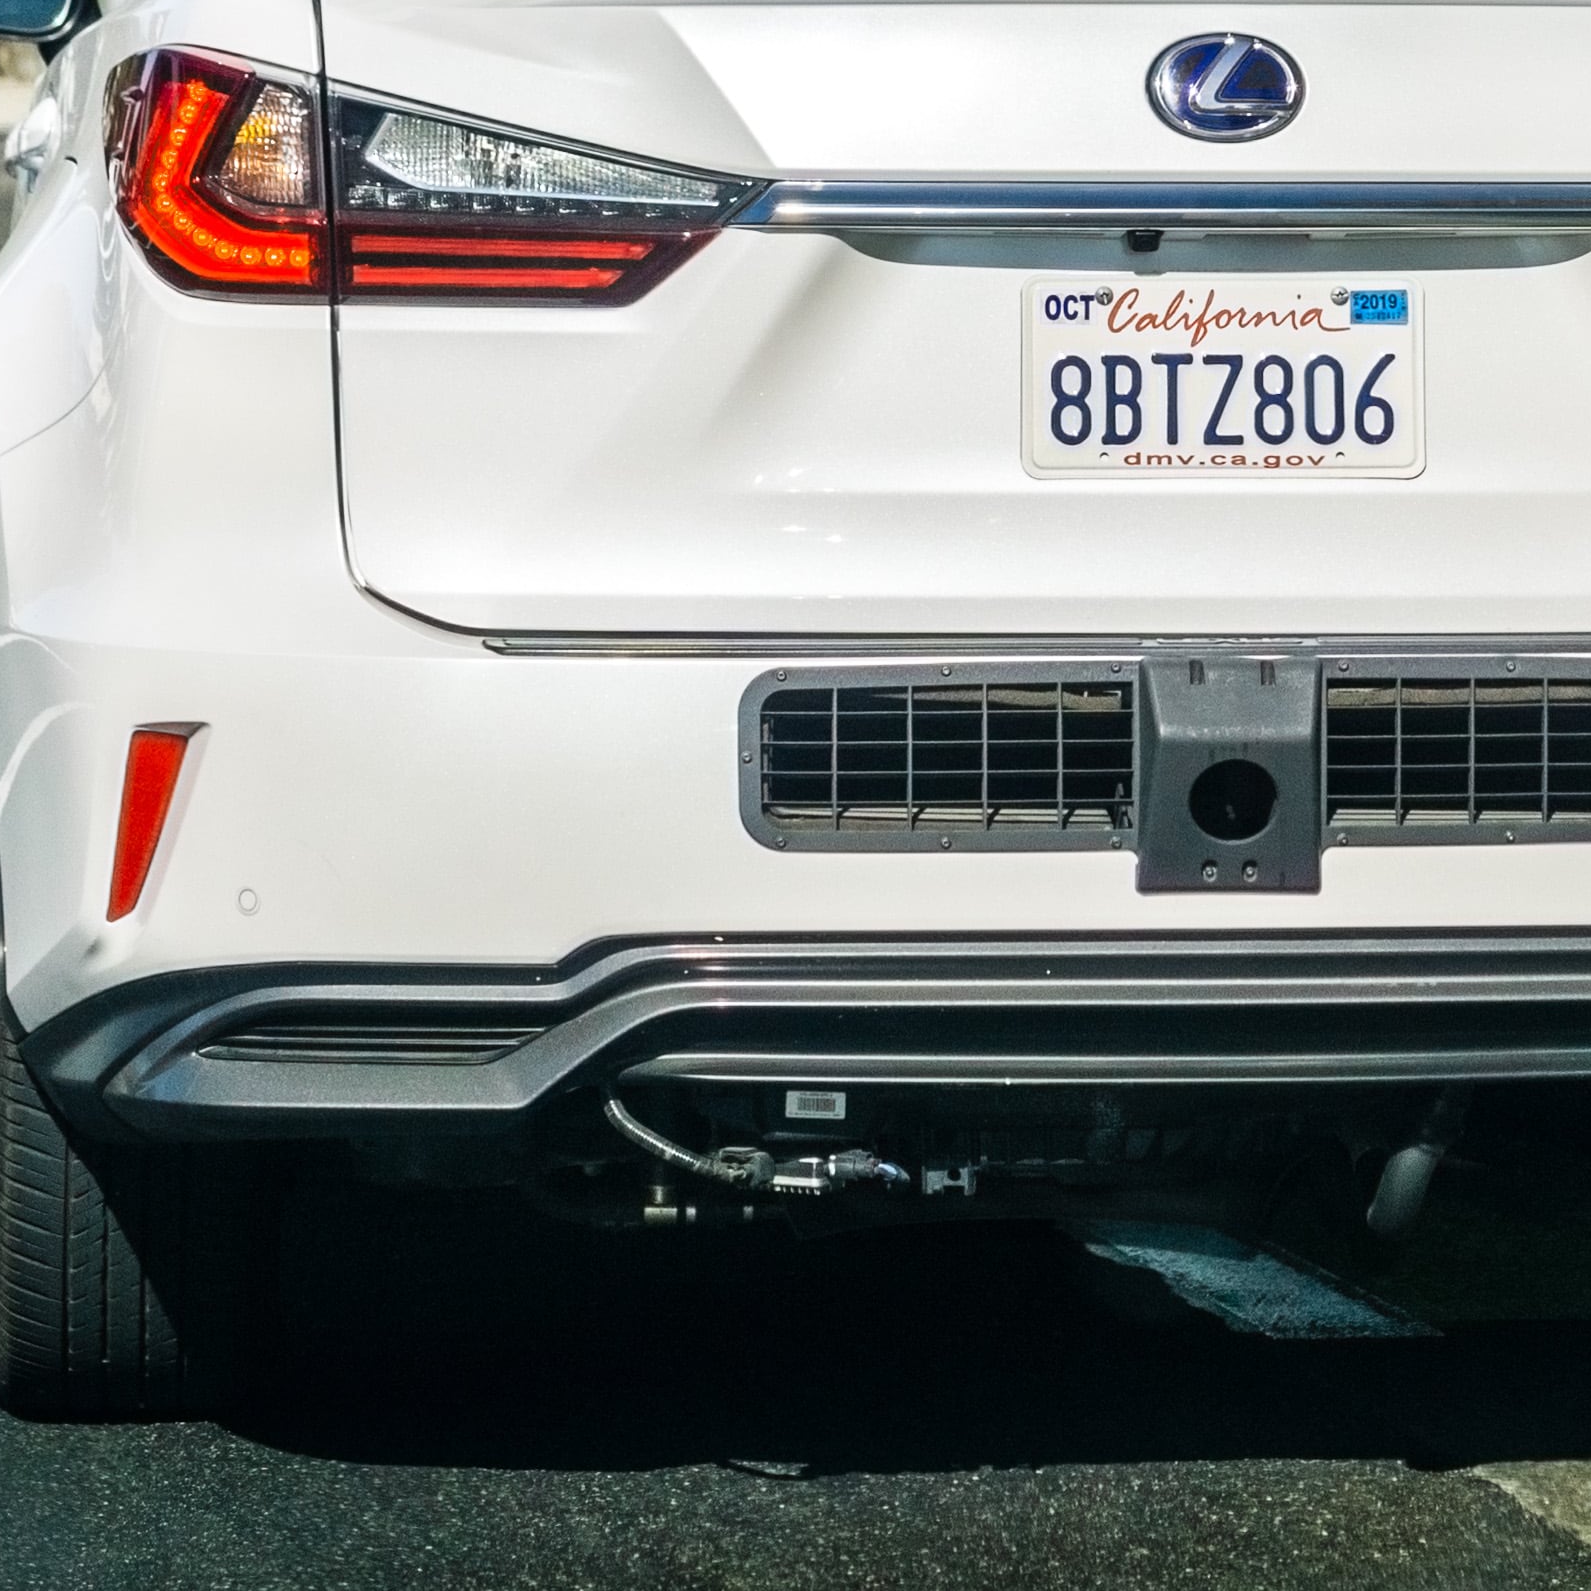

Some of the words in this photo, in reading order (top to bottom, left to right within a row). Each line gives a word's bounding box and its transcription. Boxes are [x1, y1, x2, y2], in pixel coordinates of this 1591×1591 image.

[1045, 294, 1095, 321] OCT
[1108, 288, 1350, 348] California
[1360, 293, 1398, 309] 2019
[1050, 353, 1396, 445] 8BTZ806
[1124, 452, 1325, 469] dmv.ca.gov
